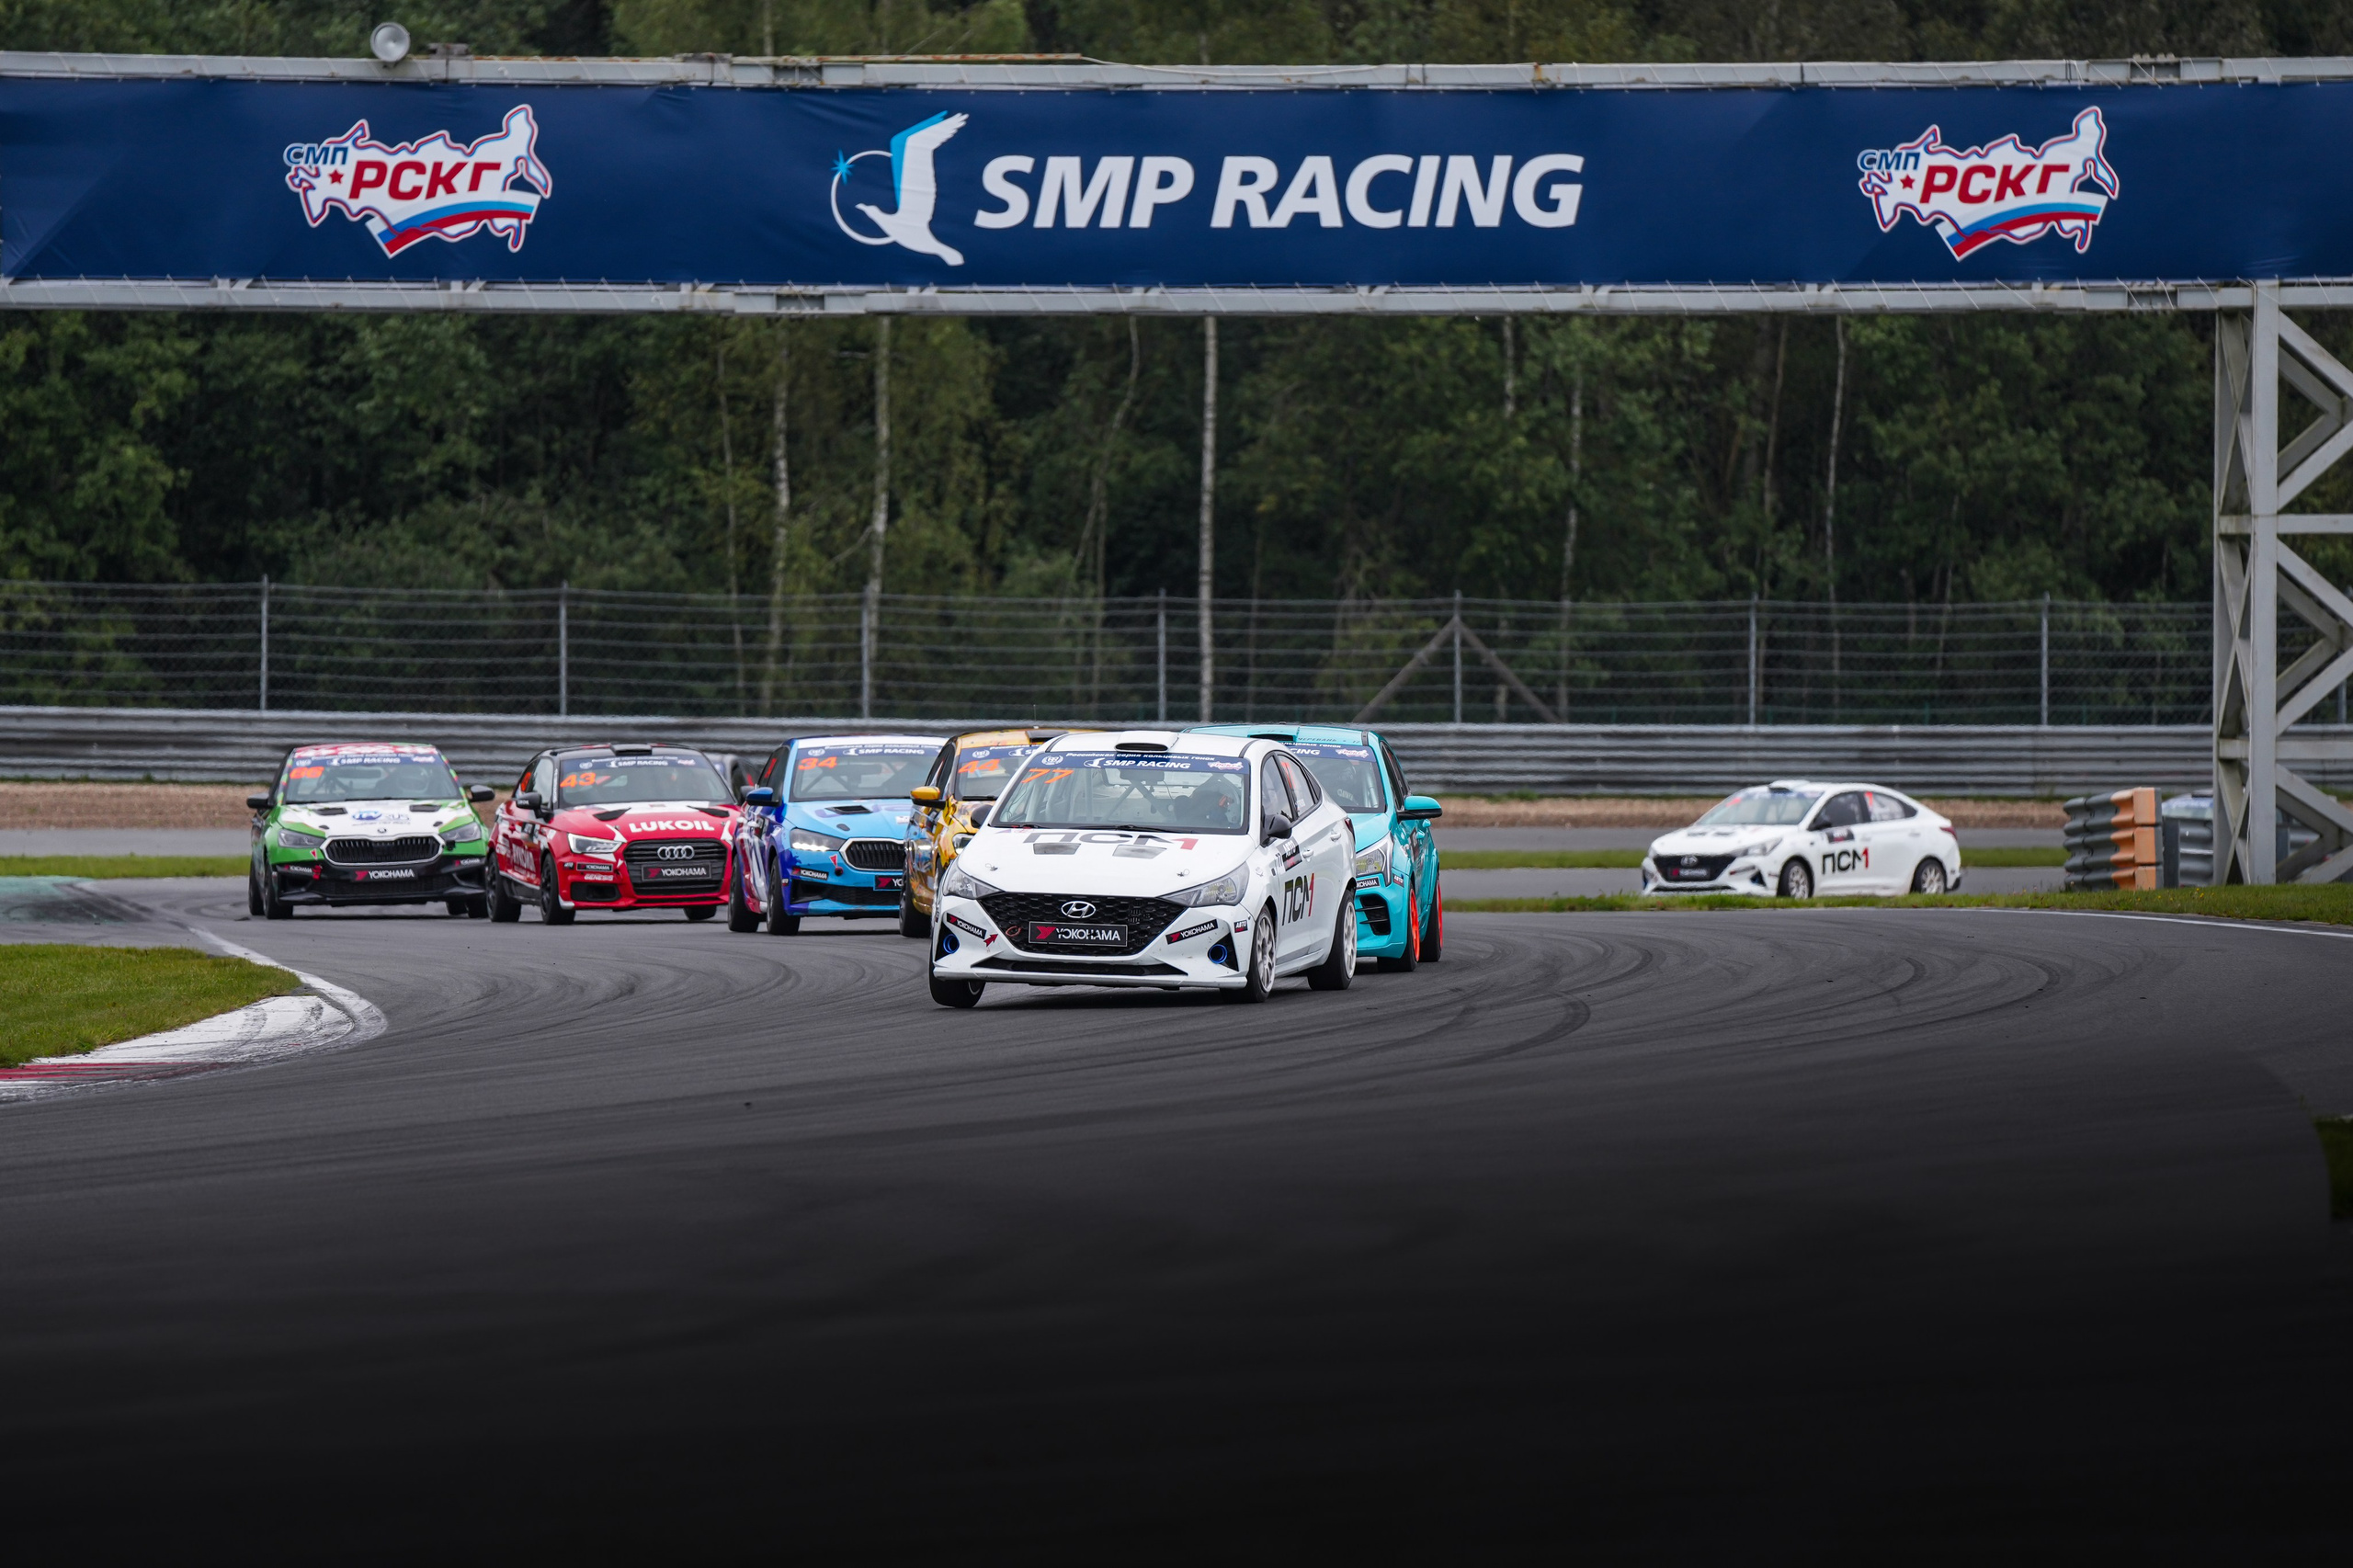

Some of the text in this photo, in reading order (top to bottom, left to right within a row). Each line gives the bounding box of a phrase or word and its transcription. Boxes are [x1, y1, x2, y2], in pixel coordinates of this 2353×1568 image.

[285, 145, 349, 165] СМП
[1859, 152, 1921, 171] СМП
[348, 160, 502, 201] РСКГ
[1918, 164, 2071, 204] РСКГ
[974, 153, 1585, 230] SMP RACING
[883, 747, 926, 756] RACING
[798, 756, 837, 771] 34
[958, 758, 1001, 774] 44
[1136, 760, 1192, 769] RACING
[560, 772, 597, 789] 43
[1020, 768, 1074, 784] 77
[630, 819, 715, 834] LUKOIL
[369, 869, 415, 880] YOKOHAMA
[661, 867, 707, 877] YOKOHAMA
[800, 869, 828, 880] YOKOHAMA
[1356, 878, 1378, 889] KOHAMA
[956, 919, 983, 937] YOKOHAMA
[1055, 927, 1121, 941] YOKOHAMA
[1180, 922, 1215, 938] YOKOHAMA
